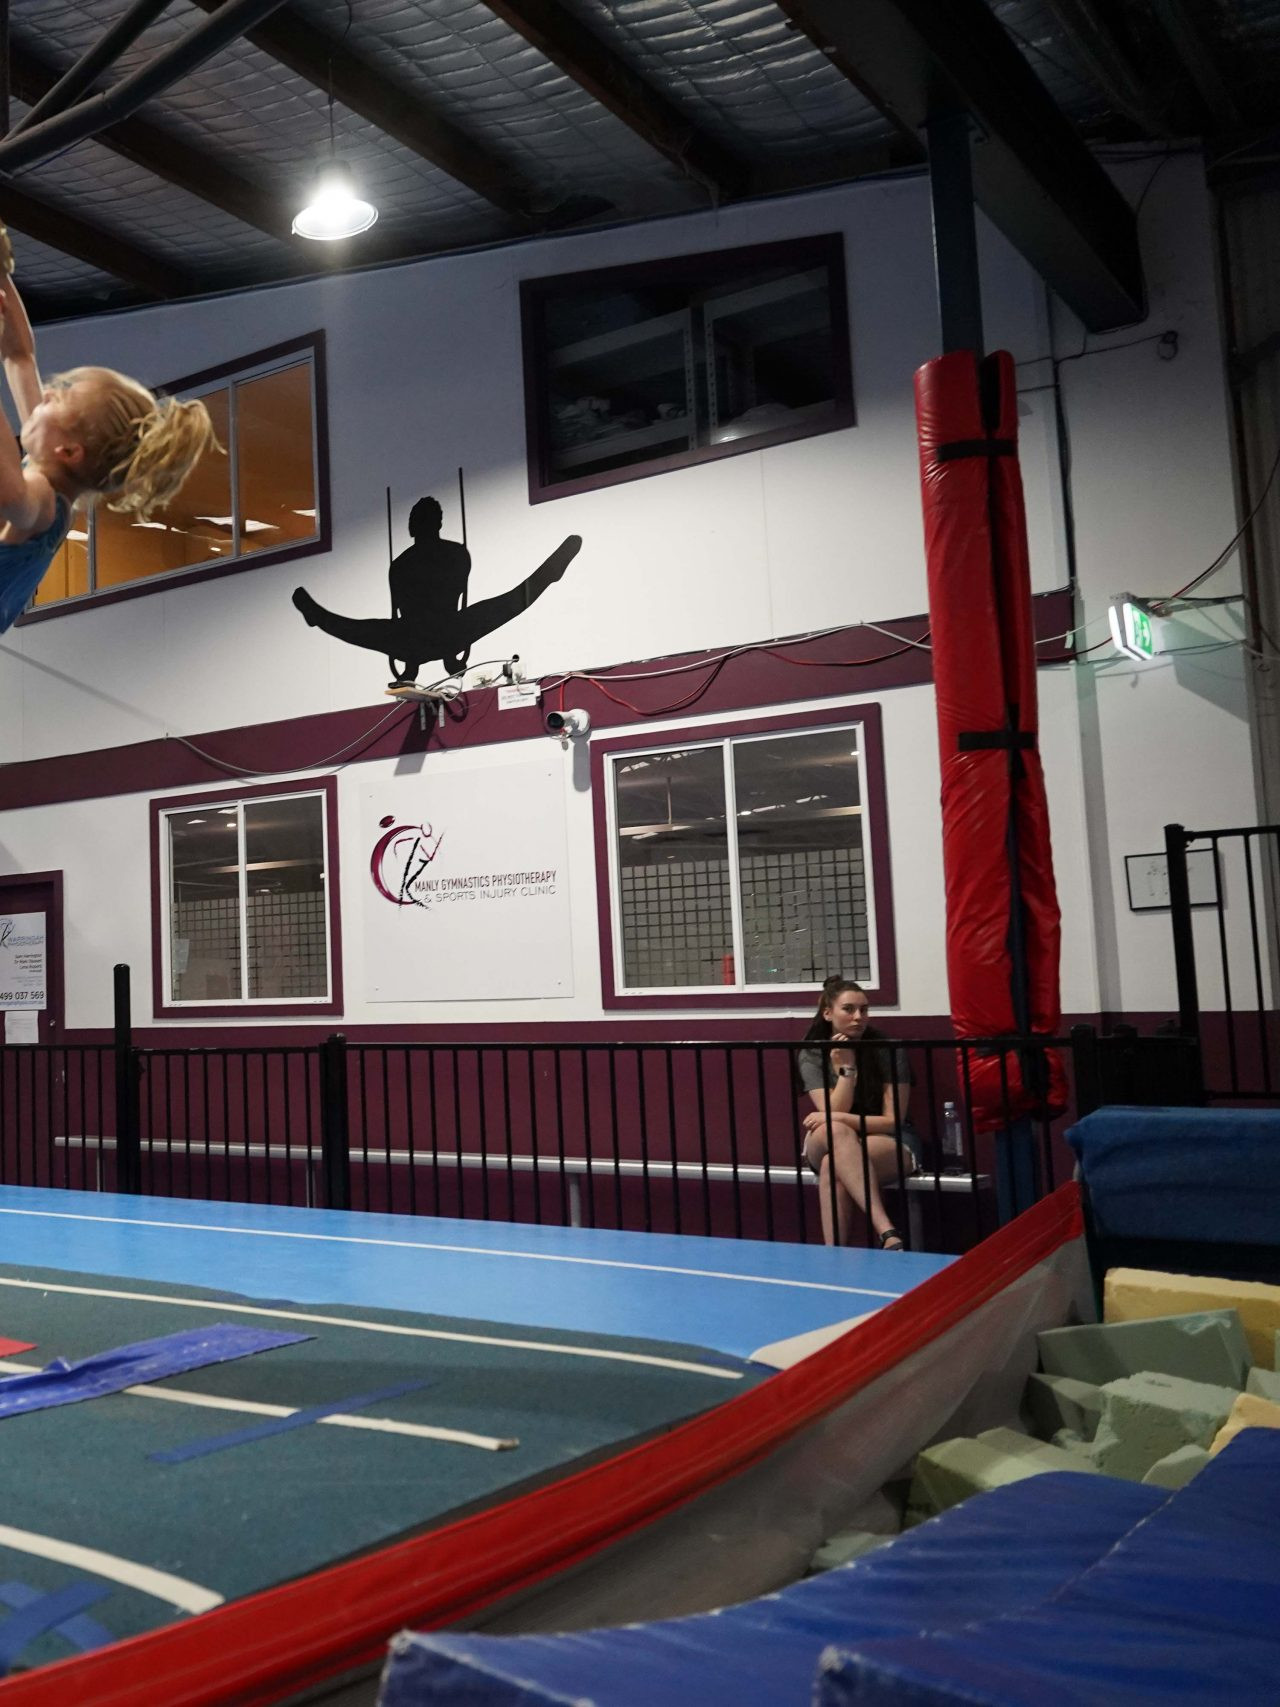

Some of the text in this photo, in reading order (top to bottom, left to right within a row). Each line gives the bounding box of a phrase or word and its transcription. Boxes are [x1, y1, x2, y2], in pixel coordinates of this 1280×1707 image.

[415, 870, 556, 892] MANLY GYMNASTICS PHYSIOTHERAPY
[437, 891, 476, 902] SPORTS
[480, 888, 517, 899] INJURY
[521, 885, 557, 897] CLINIC
[15, 992, 28, 1000] 037
[30, 991, 45, 999] 569
